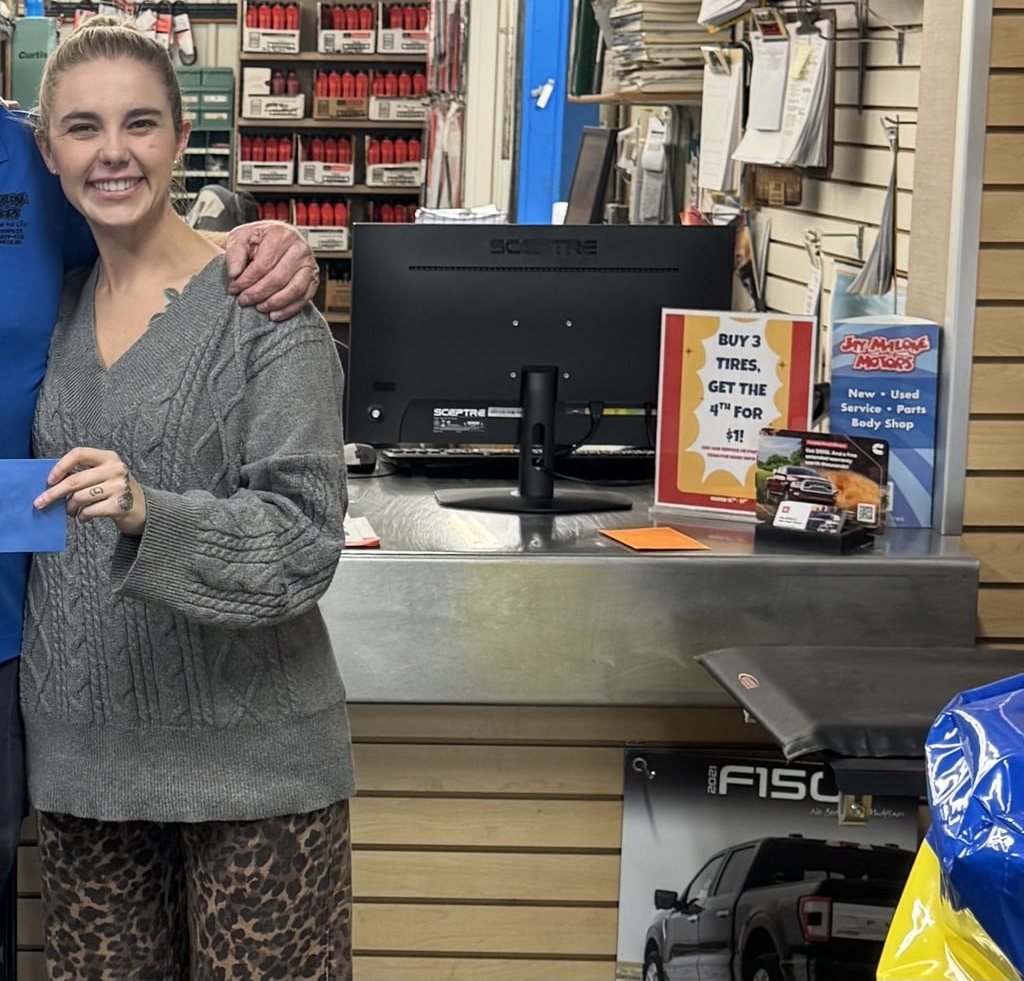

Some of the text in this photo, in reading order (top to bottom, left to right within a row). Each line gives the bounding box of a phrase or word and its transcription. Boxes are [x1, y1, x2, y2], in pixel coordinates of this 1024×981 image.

[19, 51, 48, 59] Curtis
[489, 238, 598, 256] SCEPTRE
[718, 333, 761, 348] BUY 3
[840, 334, 931, 354] JAY MALONE
[716, 357, 761, 373] TIRES,
[853, 354, 914, 373] MOTORS
[708, 380, 767, 397] GET THE
[848, 389, 920, 399] New Used
[433, 408, 486, 417] SCEPTRE
[710, 402, 763, 420] 4TH FOR
[841, 403, 927, 414] Service Parts
[851, 418, 914, 431] Body Shop
[726, 428, 744, 443] $1!
[707, 765, 717, 795] 2021
